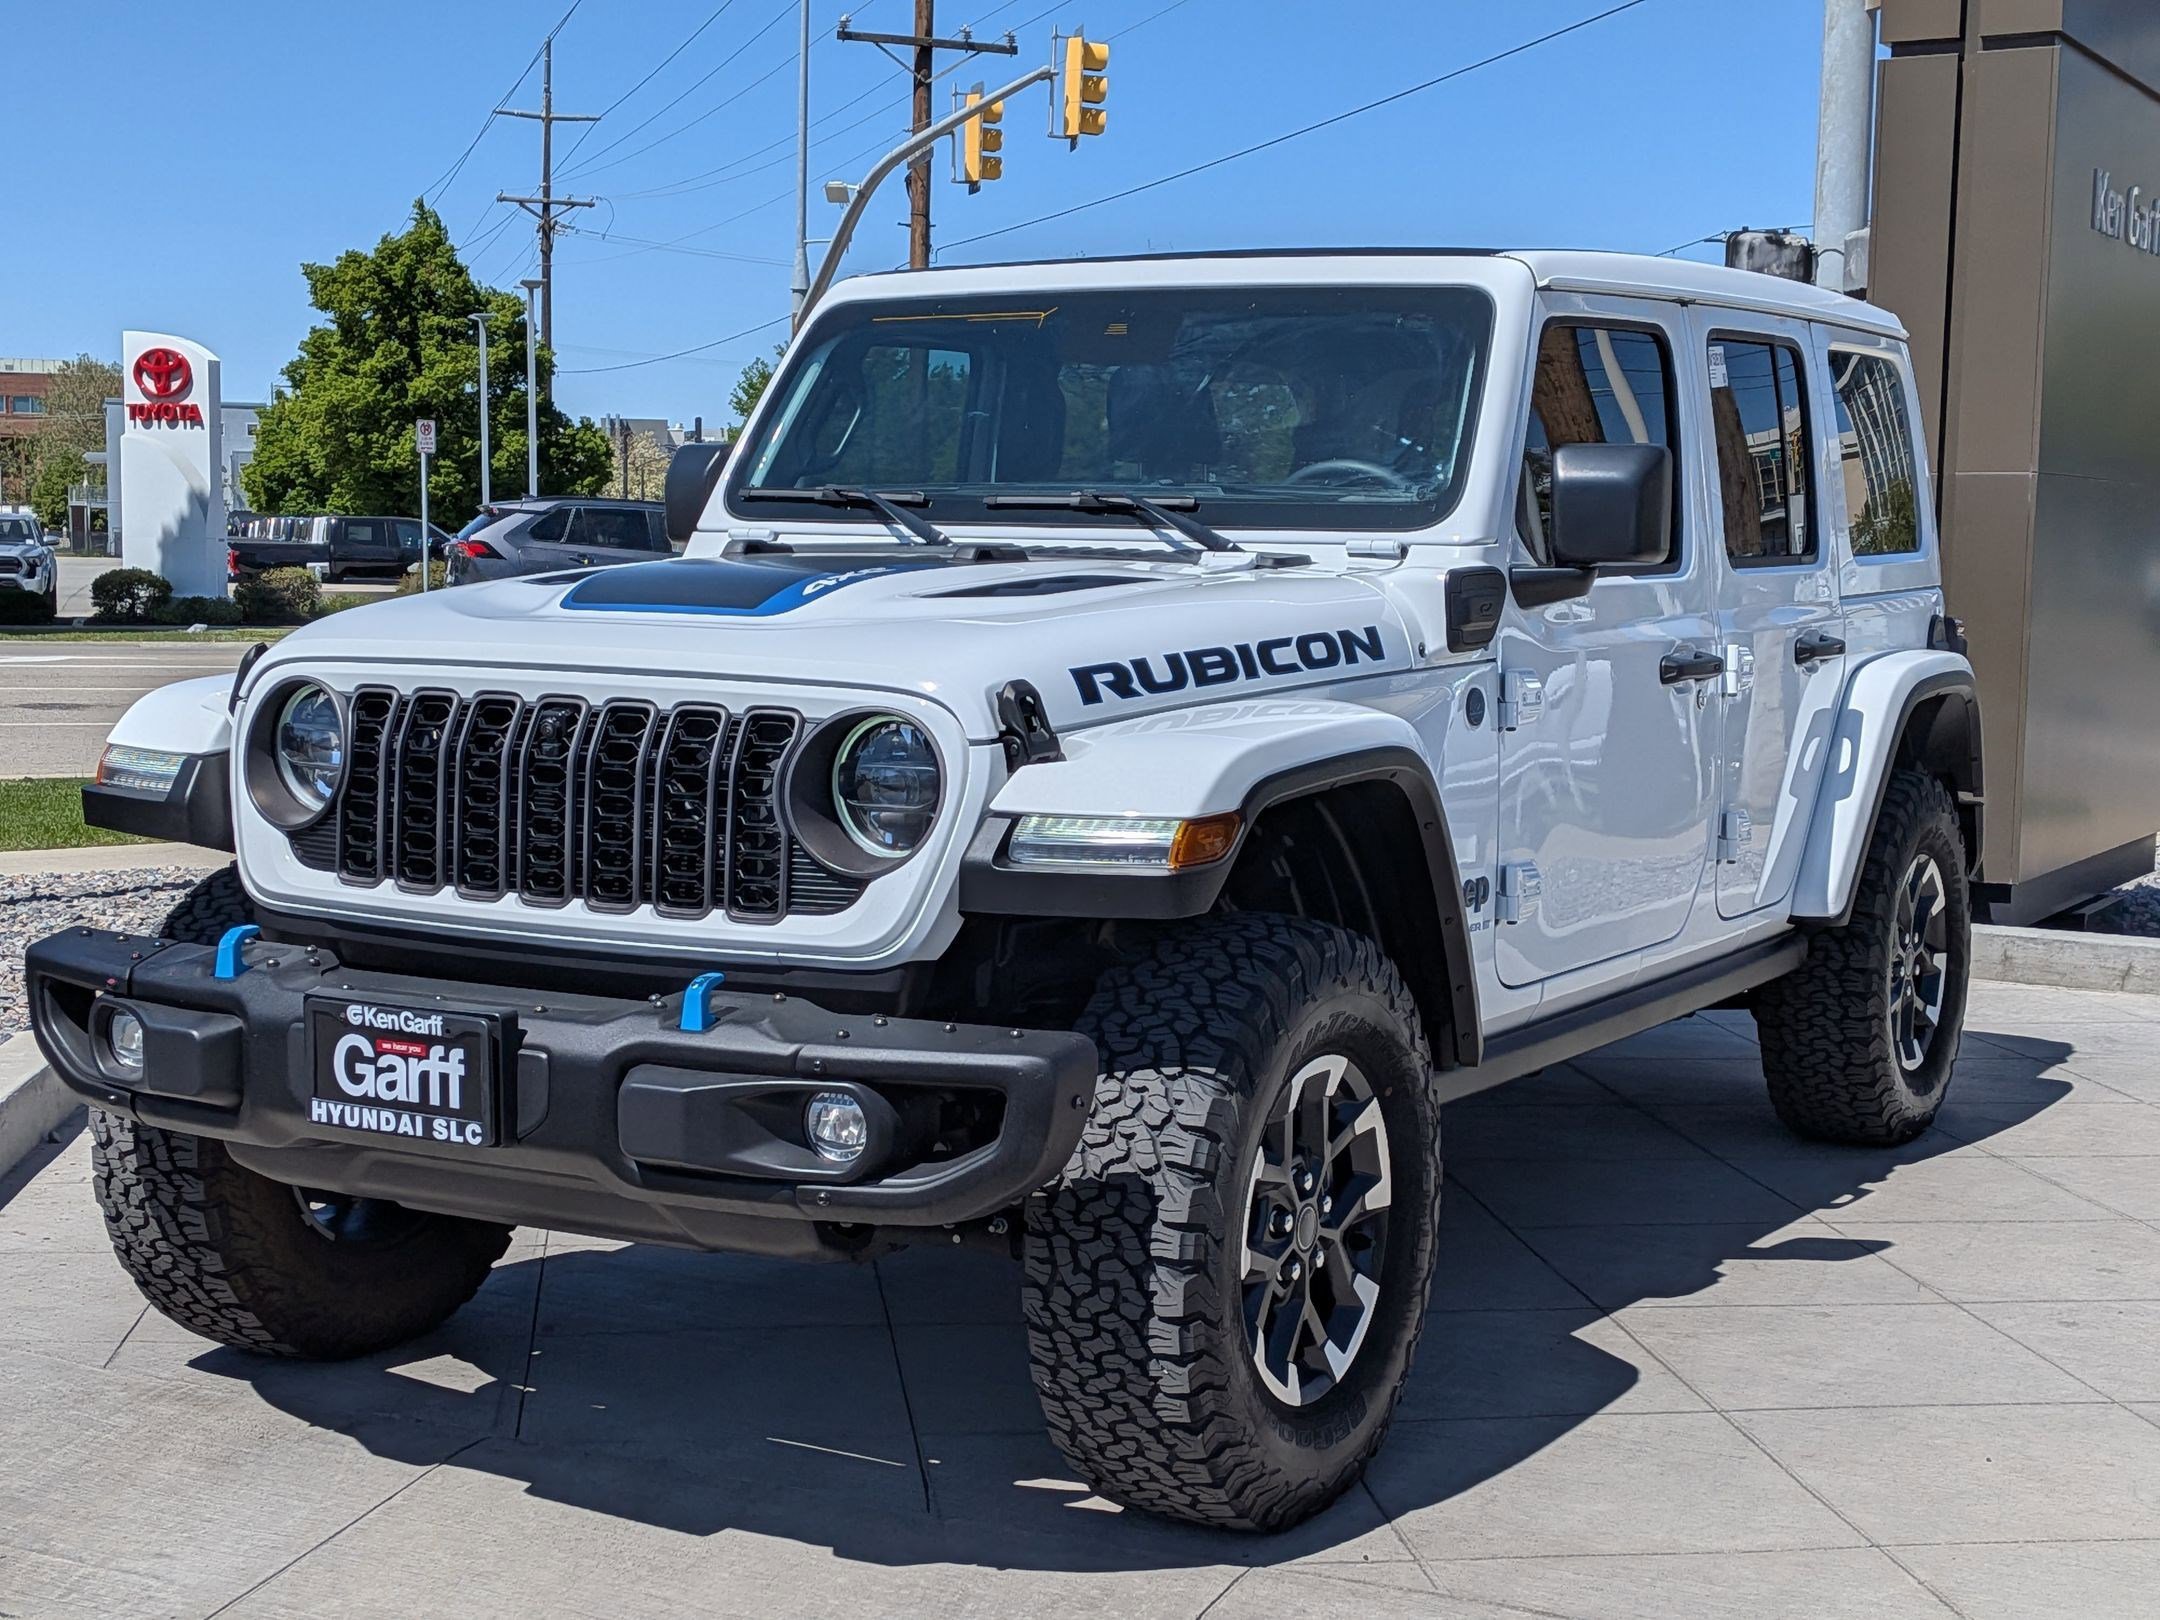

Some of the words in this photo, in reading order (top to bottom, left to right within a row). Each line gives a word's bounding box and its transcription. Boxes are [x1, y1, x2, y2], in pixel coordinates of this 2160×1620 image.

[2091, 167, 2125, 240] Ken
[125, 403, 204, 426] TOYOTA
[1068, 626, 1386, 706] RUBICON
[333, 1033, 465, 1110] Garff
[311, 1100, 423, 1137] HYUNDAI
[432, 1118, 483, 1146] SLC
